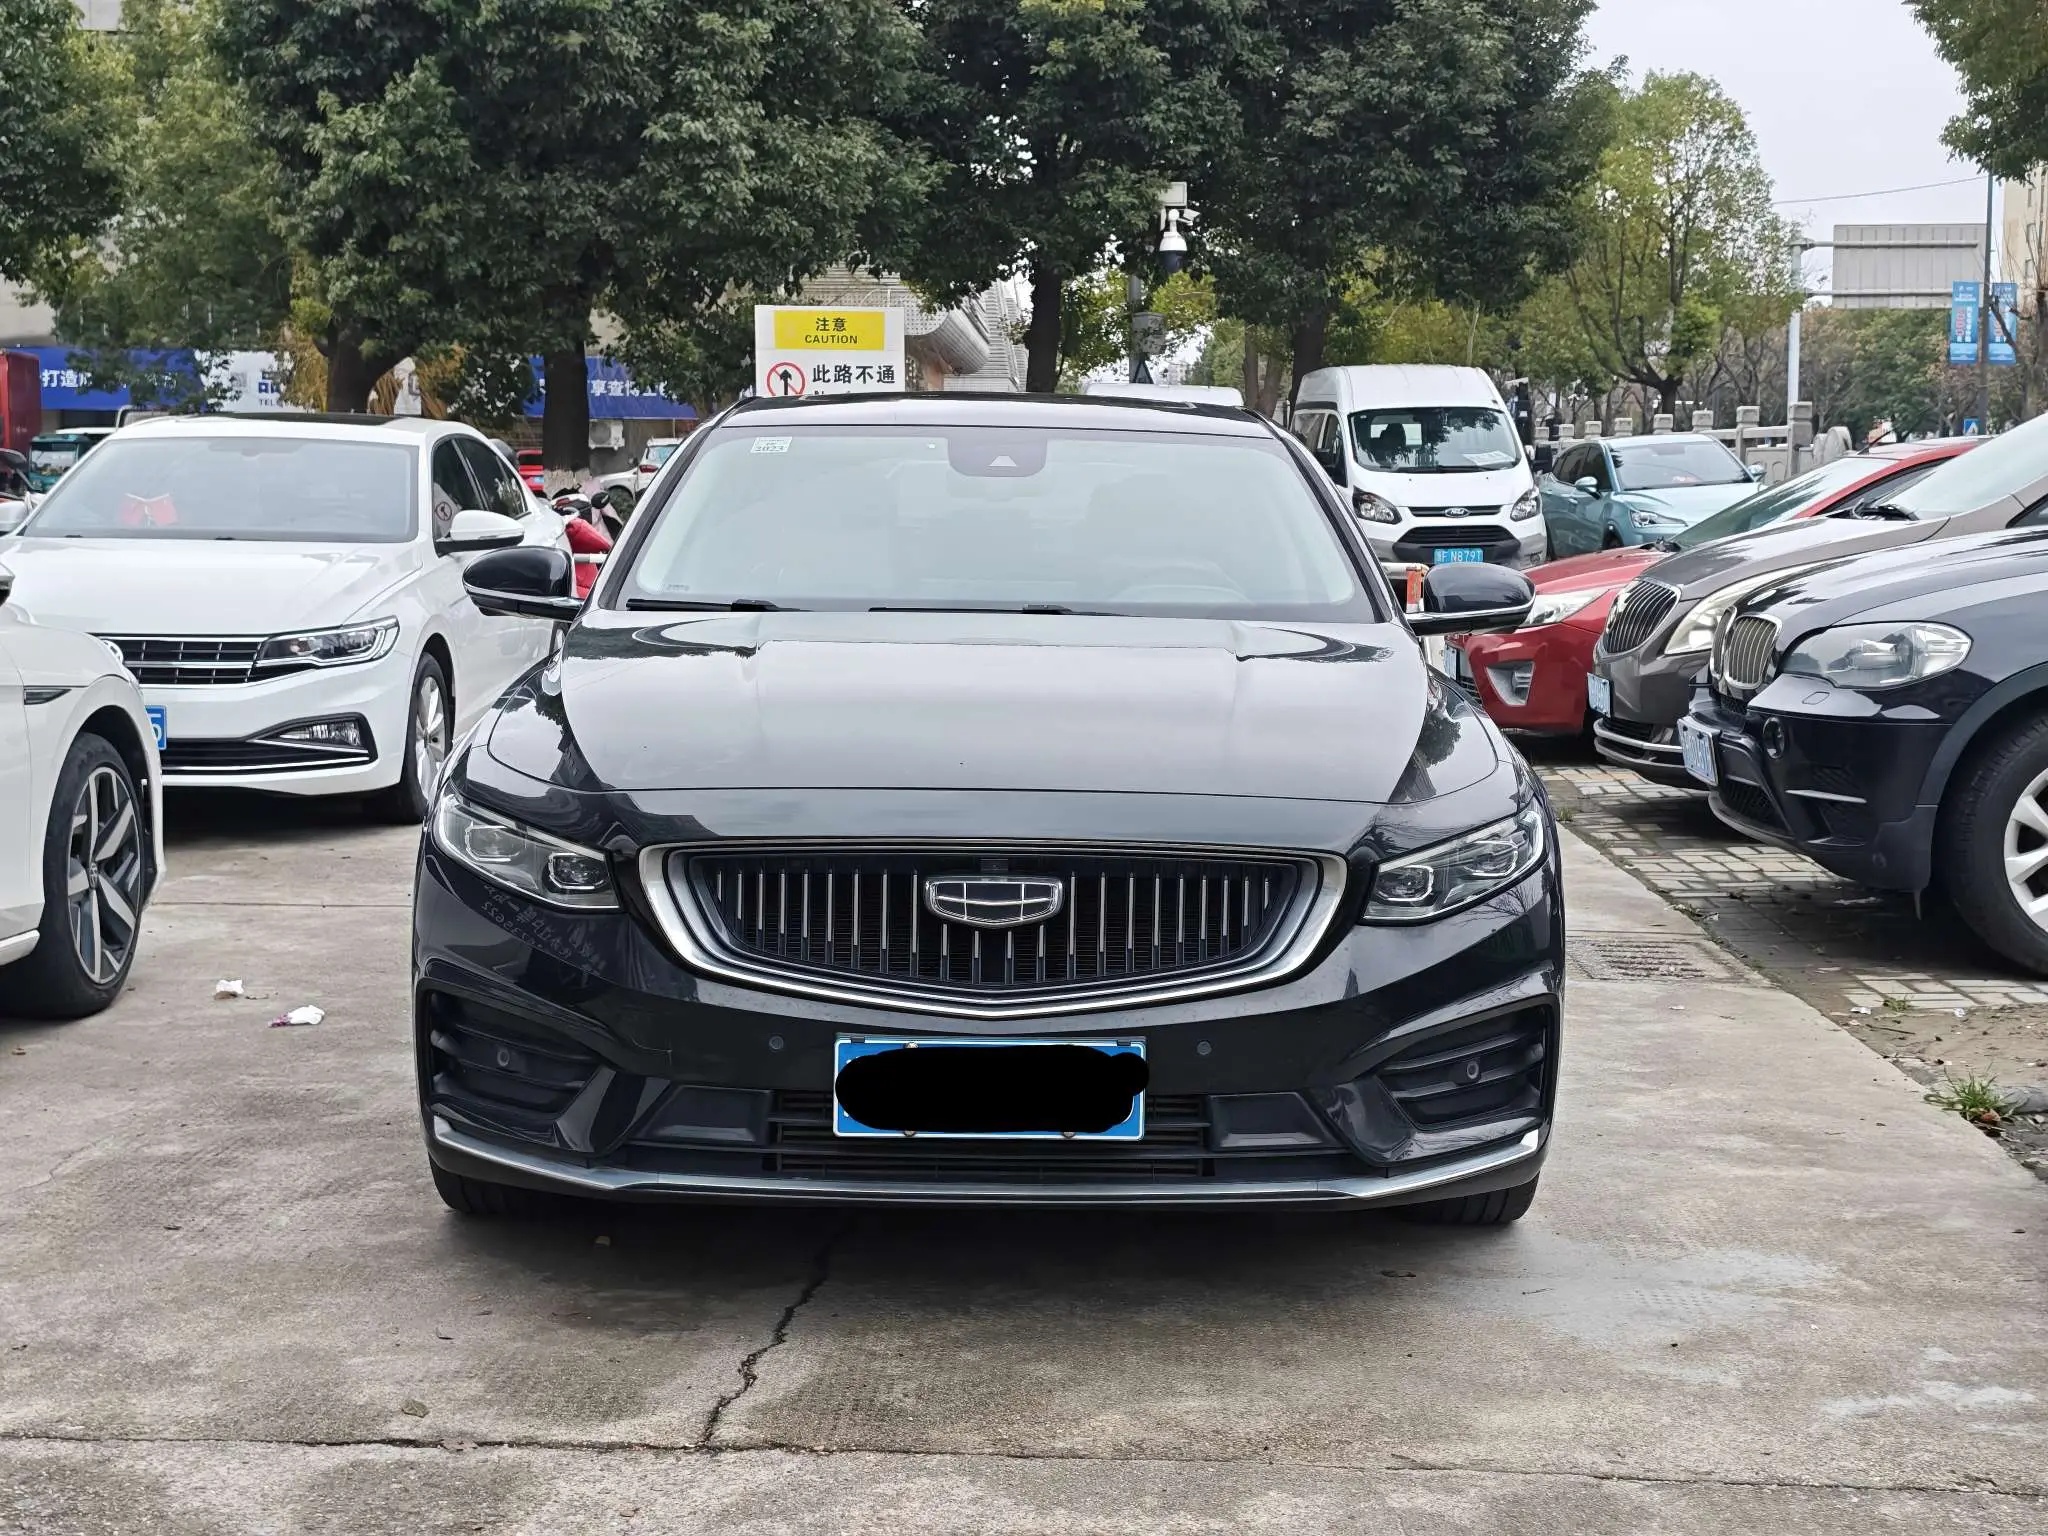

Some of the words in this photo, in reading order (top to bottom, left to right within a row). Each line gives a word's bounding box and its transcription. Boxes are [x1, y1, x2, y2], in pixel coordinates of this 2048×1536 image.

[815, 317, 847, 332] 注意
[804, 334, 858, 344] CAUTION
[812, 364, 896, 384] 此路不通
